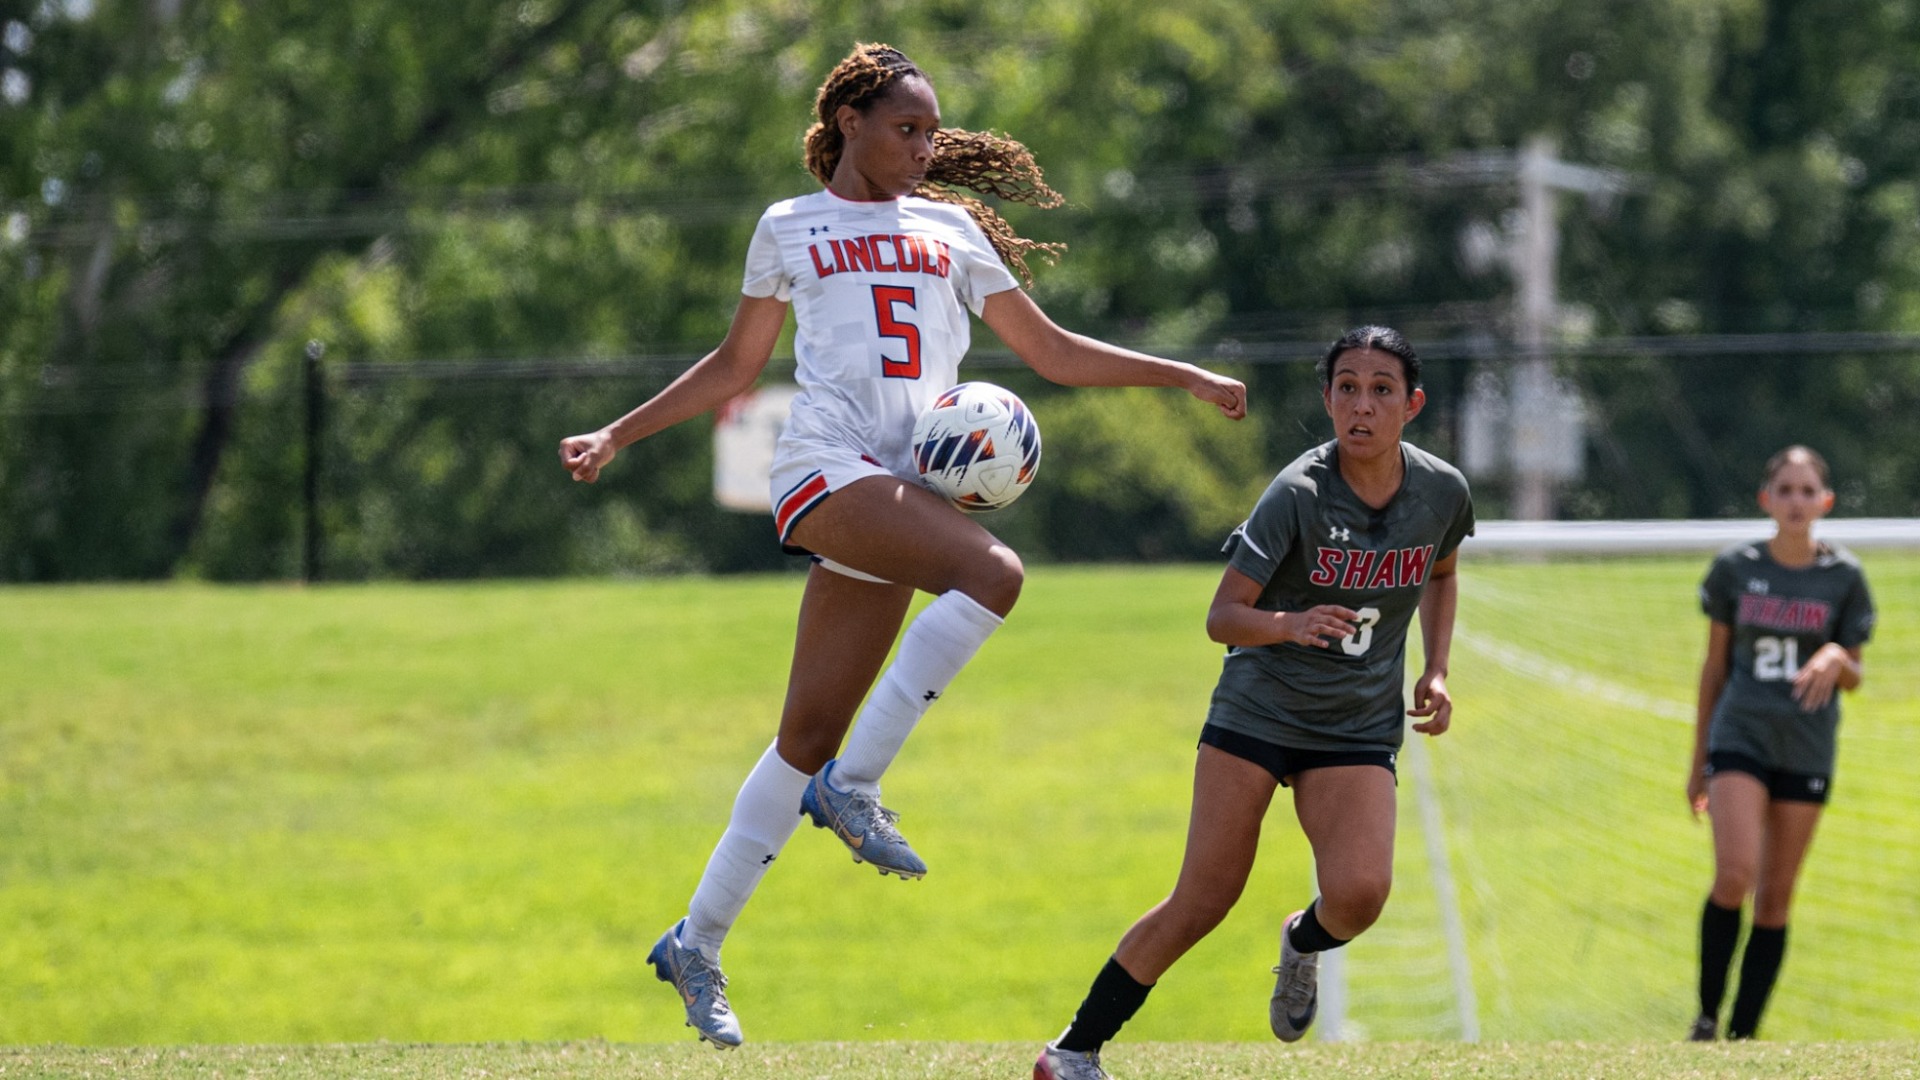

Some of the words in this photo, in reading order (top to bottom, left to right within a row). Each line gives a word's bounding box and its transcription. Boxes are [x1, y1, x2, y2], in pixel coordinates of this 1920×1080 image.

[871, 285, 921, 380] 5
[1309, 544, 1434, 589] SHAW
[1341, 607, 1381, 656] 3
[1737, 595, 1830, 630] SHAW
[1753, 636, 1799, 682] 21
